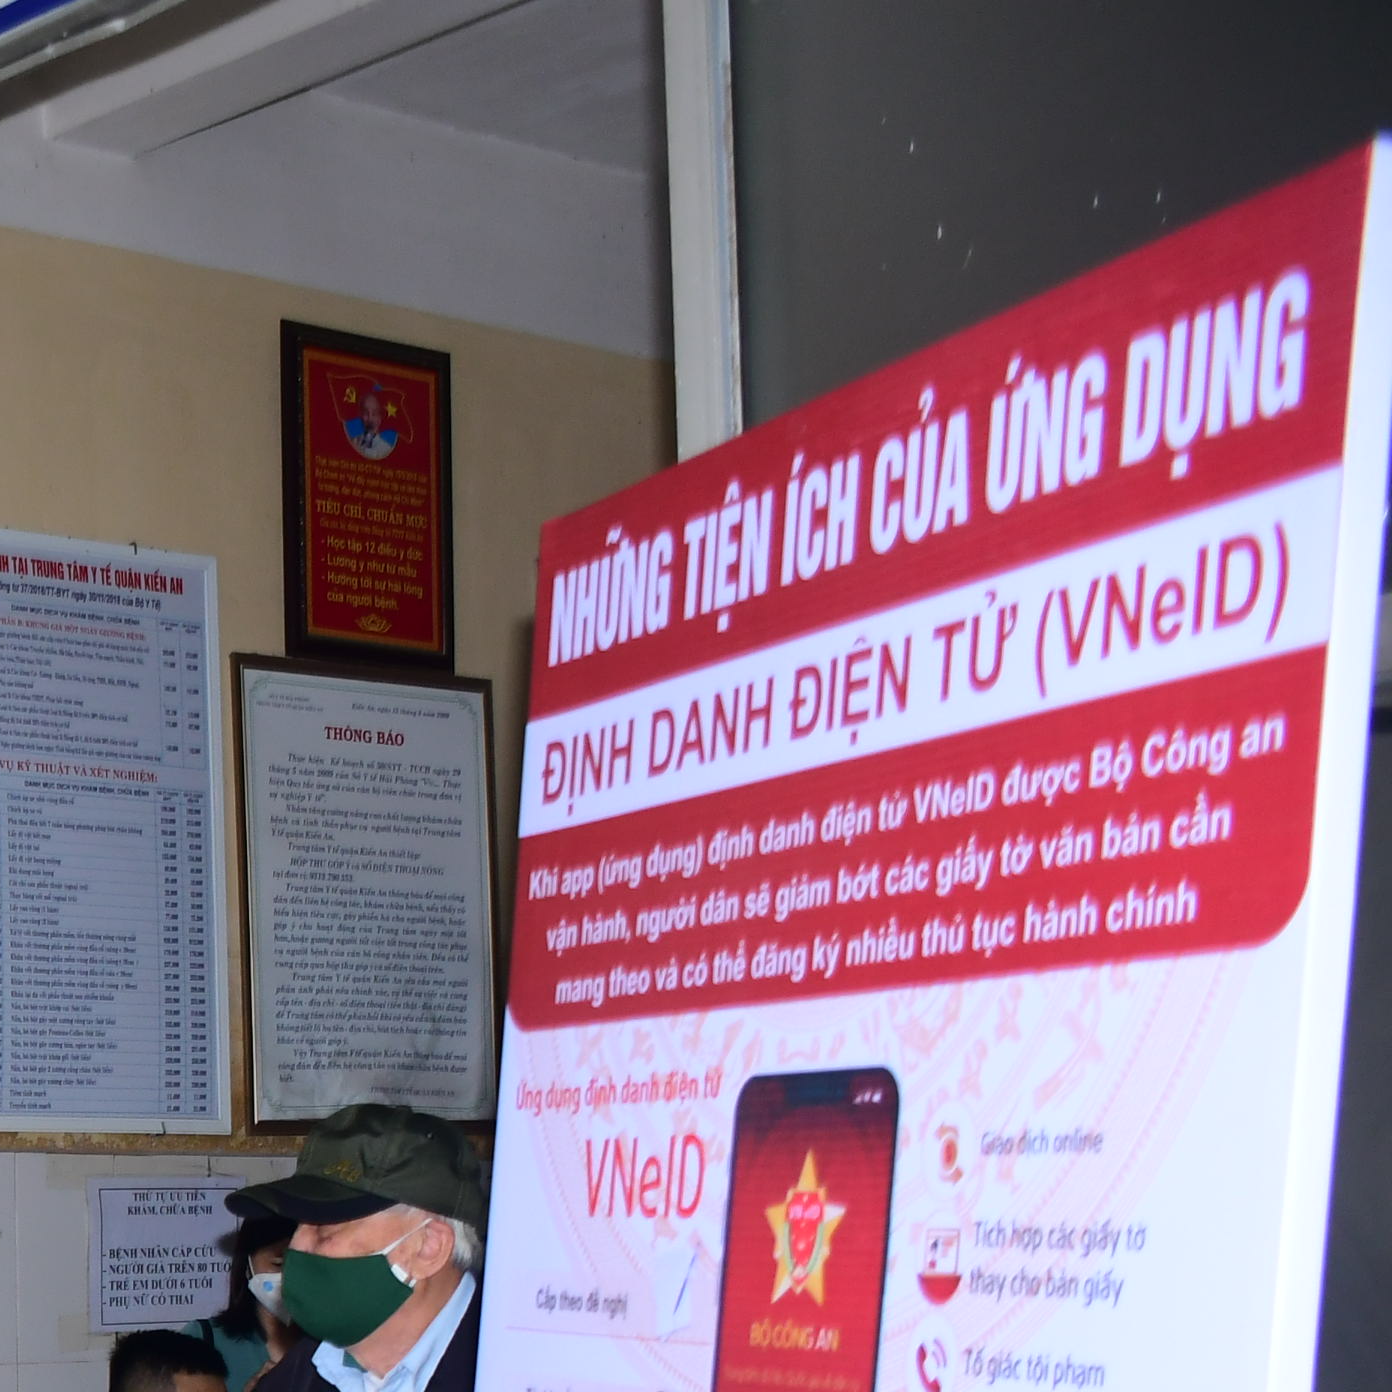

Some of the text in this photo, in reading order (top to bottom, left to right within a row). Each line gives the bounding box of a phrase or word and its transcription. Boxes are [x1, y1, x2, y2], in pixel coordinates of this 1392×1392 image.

[548, 265, 1311, 667] NHỮNG TIỆN ÍCH CỦA ỨNG DỤNG
[327, 535, 344, 550] Học
[365, 541, 376, 554] 12
[11, 556, 28, 579] TẠI
[30, 558, 64, 580] TRUNG
[66, 560, 88, 583] TÂM
[90, 566, 97, 584] Y
[99, 562, 112, 586] TẾ
[114, 567, 142, 593] QUẬN
[143, 569, 167, 593] KIẾN
[170, 577, 184, 595] AN
[542, 520, 1291, 816] ĐỊNH DANH ĐIỆN TỬ (VNeID)
[325, 725, 405, 746] THÔNG BÁO
[528, 714, 1285, 900] Khi app (ứng dụng) định danh điện tử VNeID được Bộ Công an
[585, 1133, 705, 1220] VNeID
[108, 1246, 137, 1262] BỆNH
[140, 1245, 169, 1259] NHÂN
[171, 1244, 192, 1257] CẤP
[109, 1261, 144, 1275] NGƯỜI
[146, 1261, 165, 1274] GIÀ
[167, 1260, 194, 1273] TRÊN
[197, 1262, 207, 1273] 80
[109, 1276, 213, 1291] TRẺ EM DƯỚI 6 TUỔI
[109, 1292, 194, 1310] PHỤ NỮ CÓ THAI
